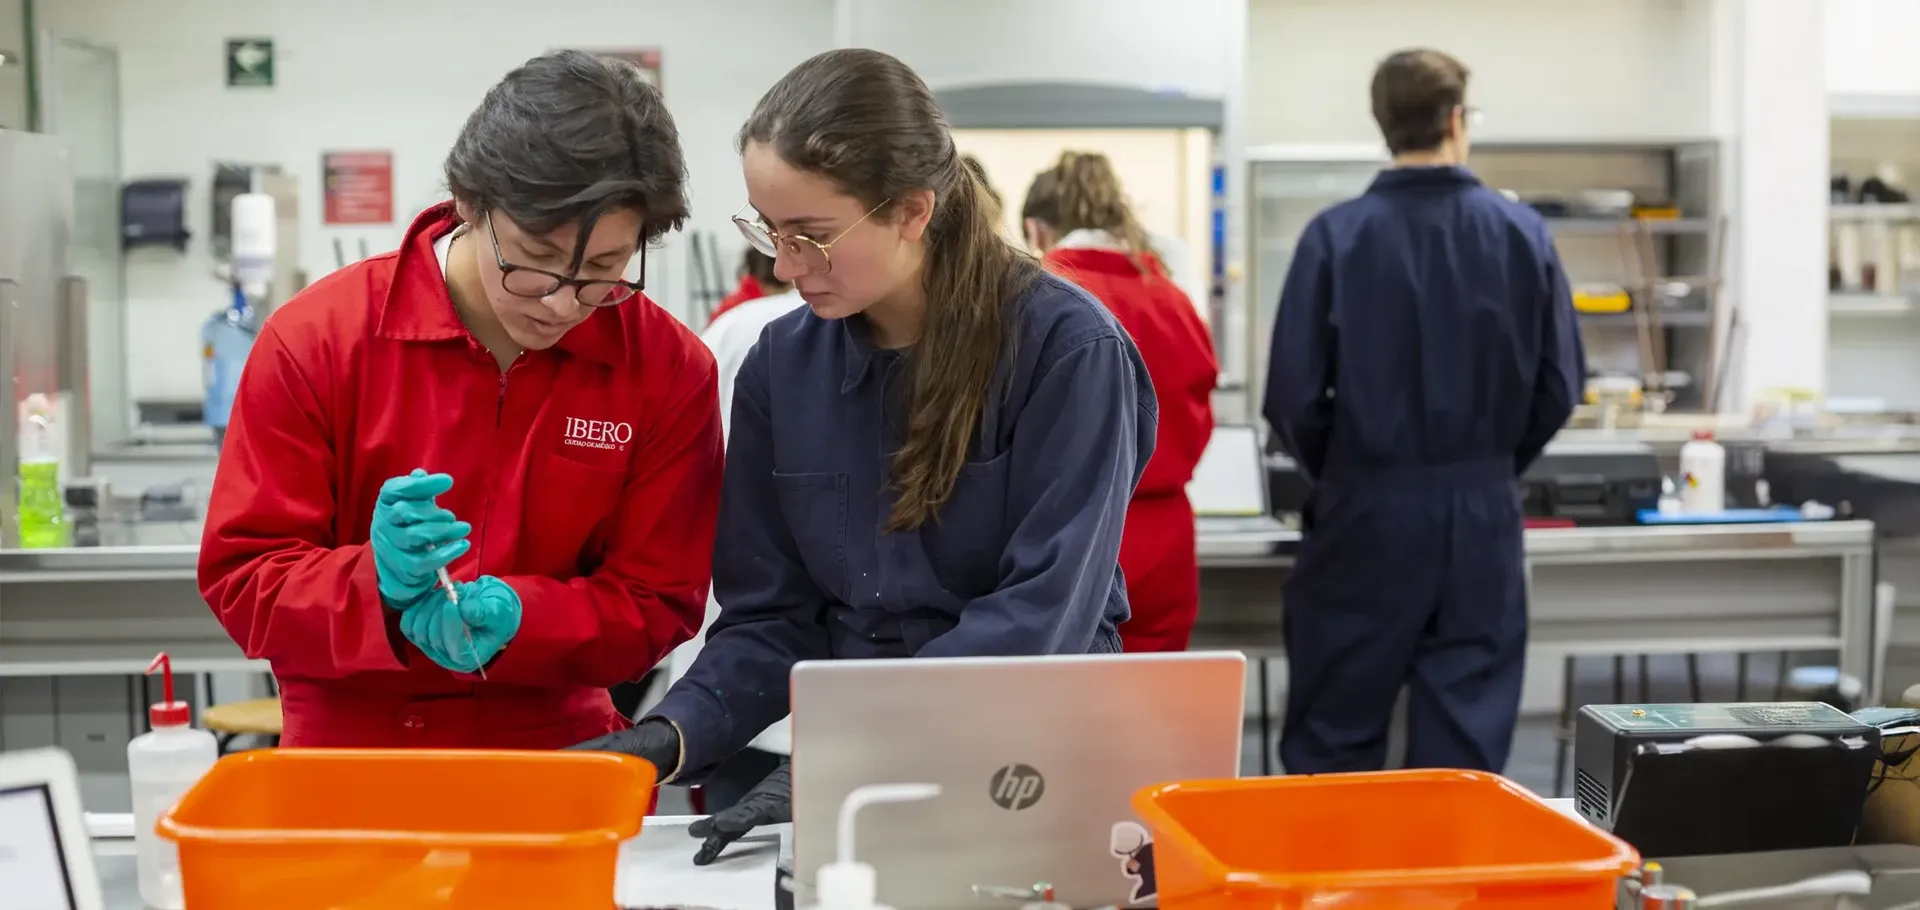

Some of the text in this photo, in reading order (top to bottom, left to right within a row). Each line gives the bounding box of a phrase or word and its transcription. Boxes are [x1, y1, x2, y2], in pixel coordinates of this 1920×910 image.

[564, 416, 632, 443] IBERO
[564, 438, 586, 447] CIUDAD
[995, 763, 1040, 811] hp
